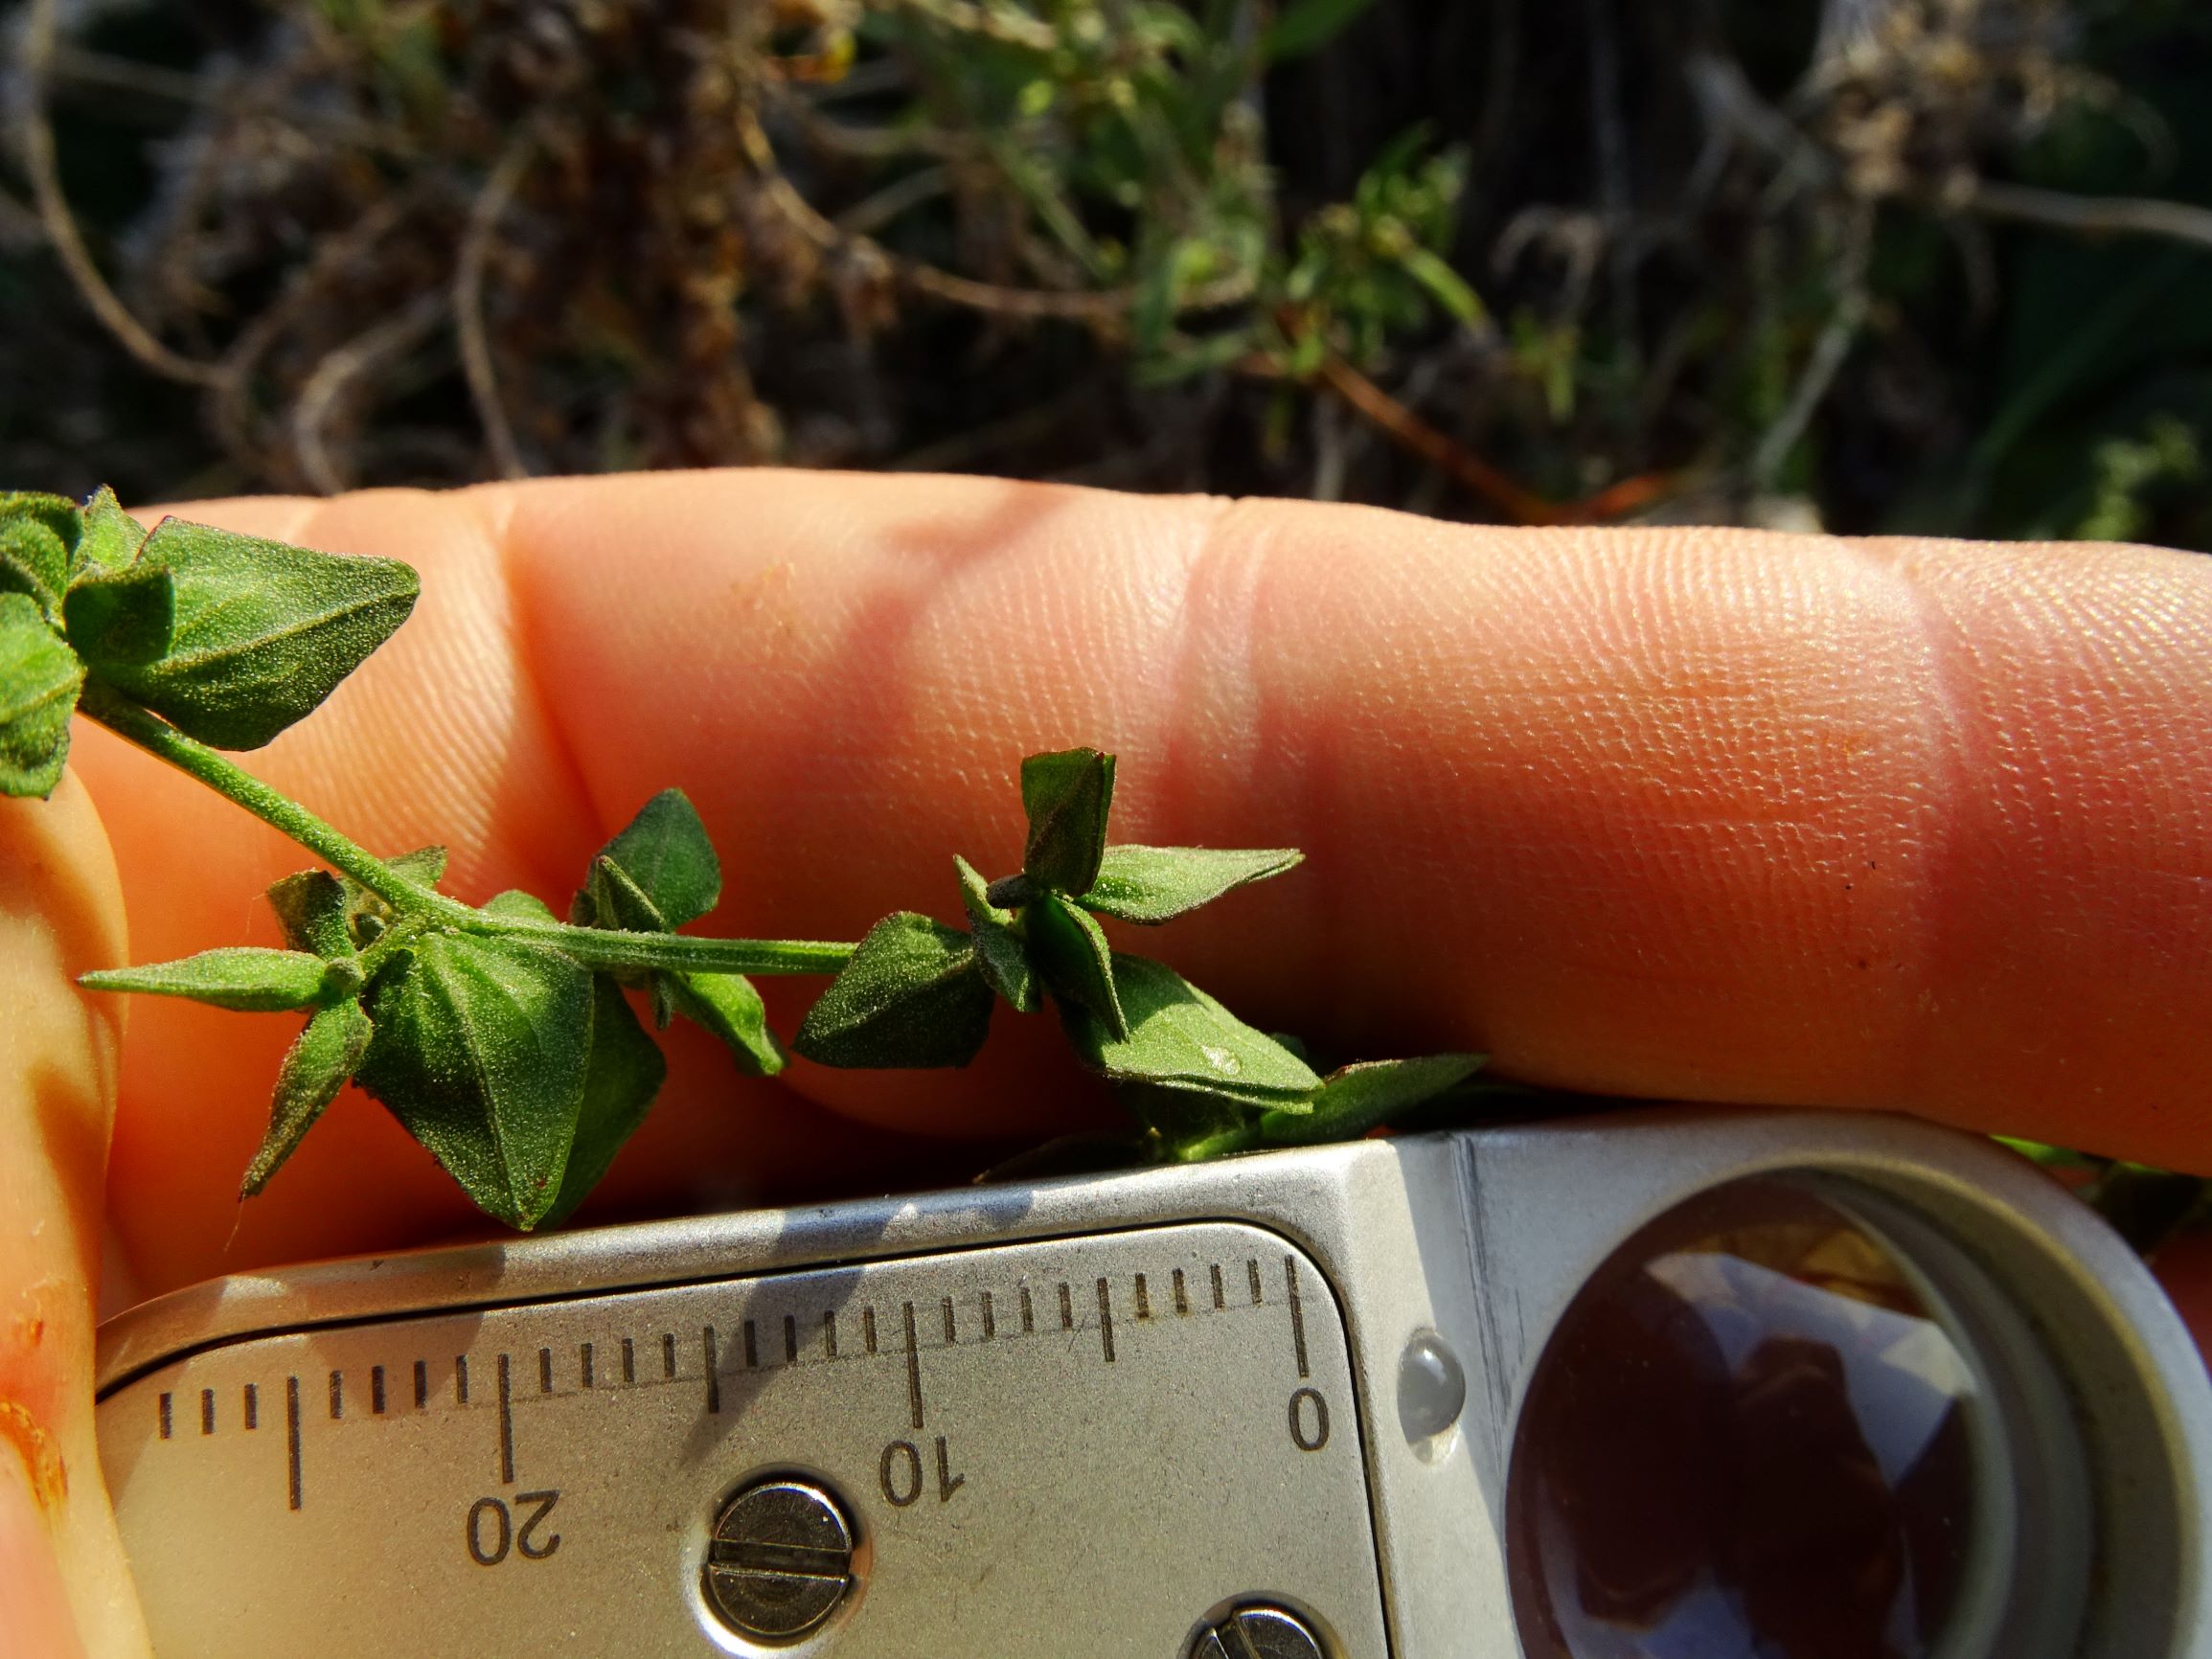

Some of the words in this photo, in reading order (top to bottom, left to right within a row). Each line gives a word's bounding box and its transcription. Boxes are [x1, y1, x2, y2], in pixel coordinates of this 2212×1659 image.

[1289, 1388, 1330, 1451] 0
[880, 1436, 965, 1507] 10
[467, 1489, 559, 1566] 20
